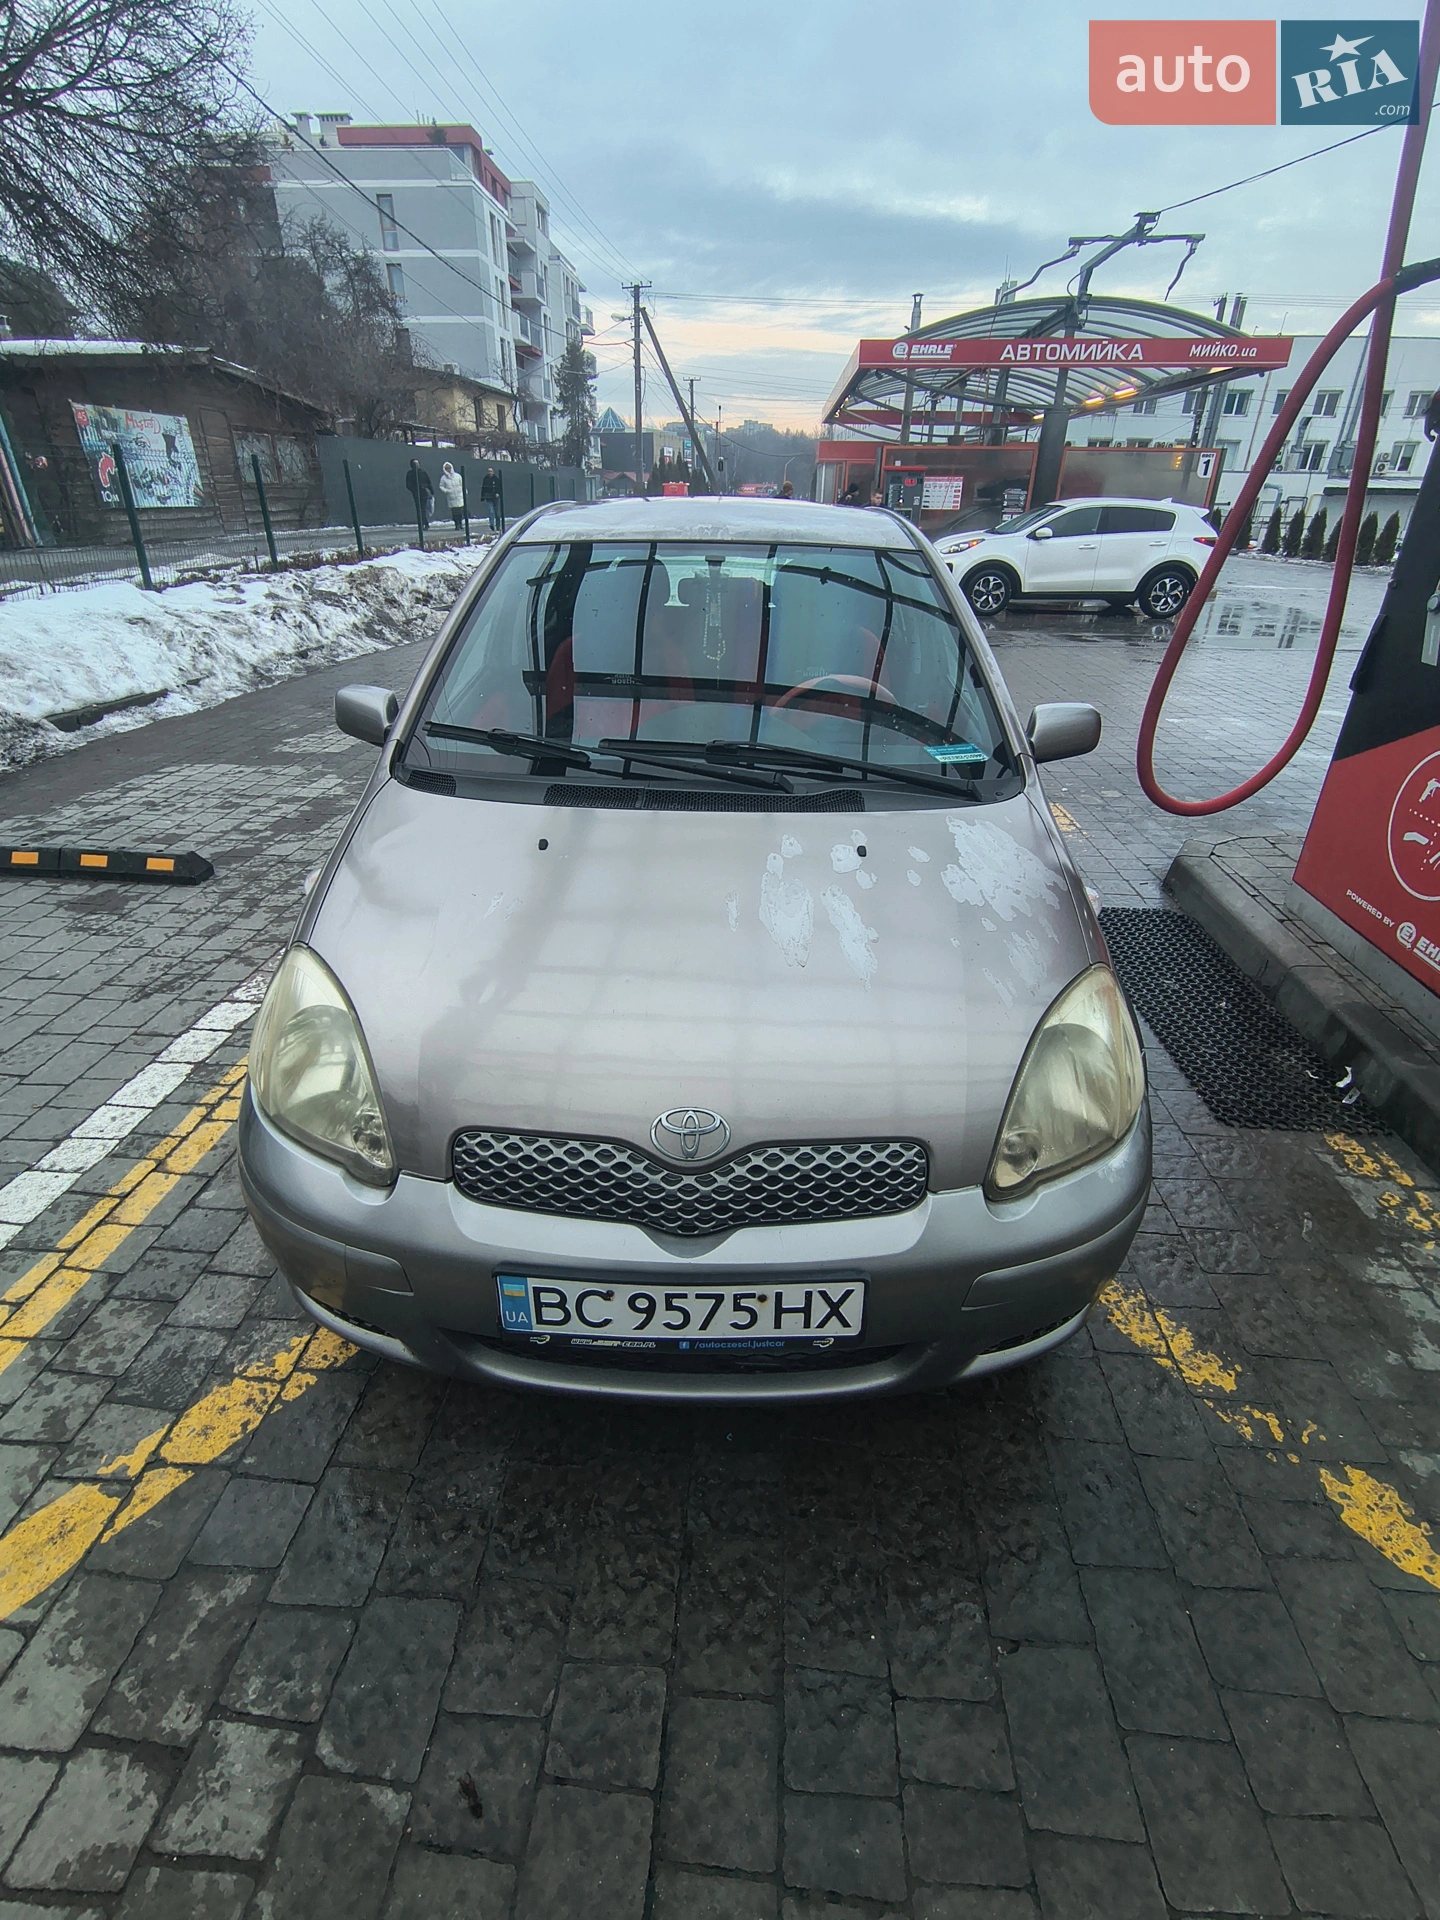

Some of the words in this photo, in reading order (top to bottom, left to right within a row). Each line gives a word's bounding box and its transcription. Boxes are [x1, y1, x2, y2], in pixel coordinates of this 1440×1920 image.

[910, 344, 954, 354] EHRLE
[999, 340, 1144, 361] АВТОМИЙКА
[1189, 341, 1258, 358] МИЙКО.ua
[1203, 459, 1210, 476] 1
[1346, 889, 1382, 919] POWERED
[1383, 916, 1395, 928] BY
[1416, 936, 1440, 962] EH
[505, 1310, 529, 1325] UA
[532, 1286, 613, 1329] BC
[627, 1291, 758, 1331] 9575
[774, 1288, 855, 1329] HX
